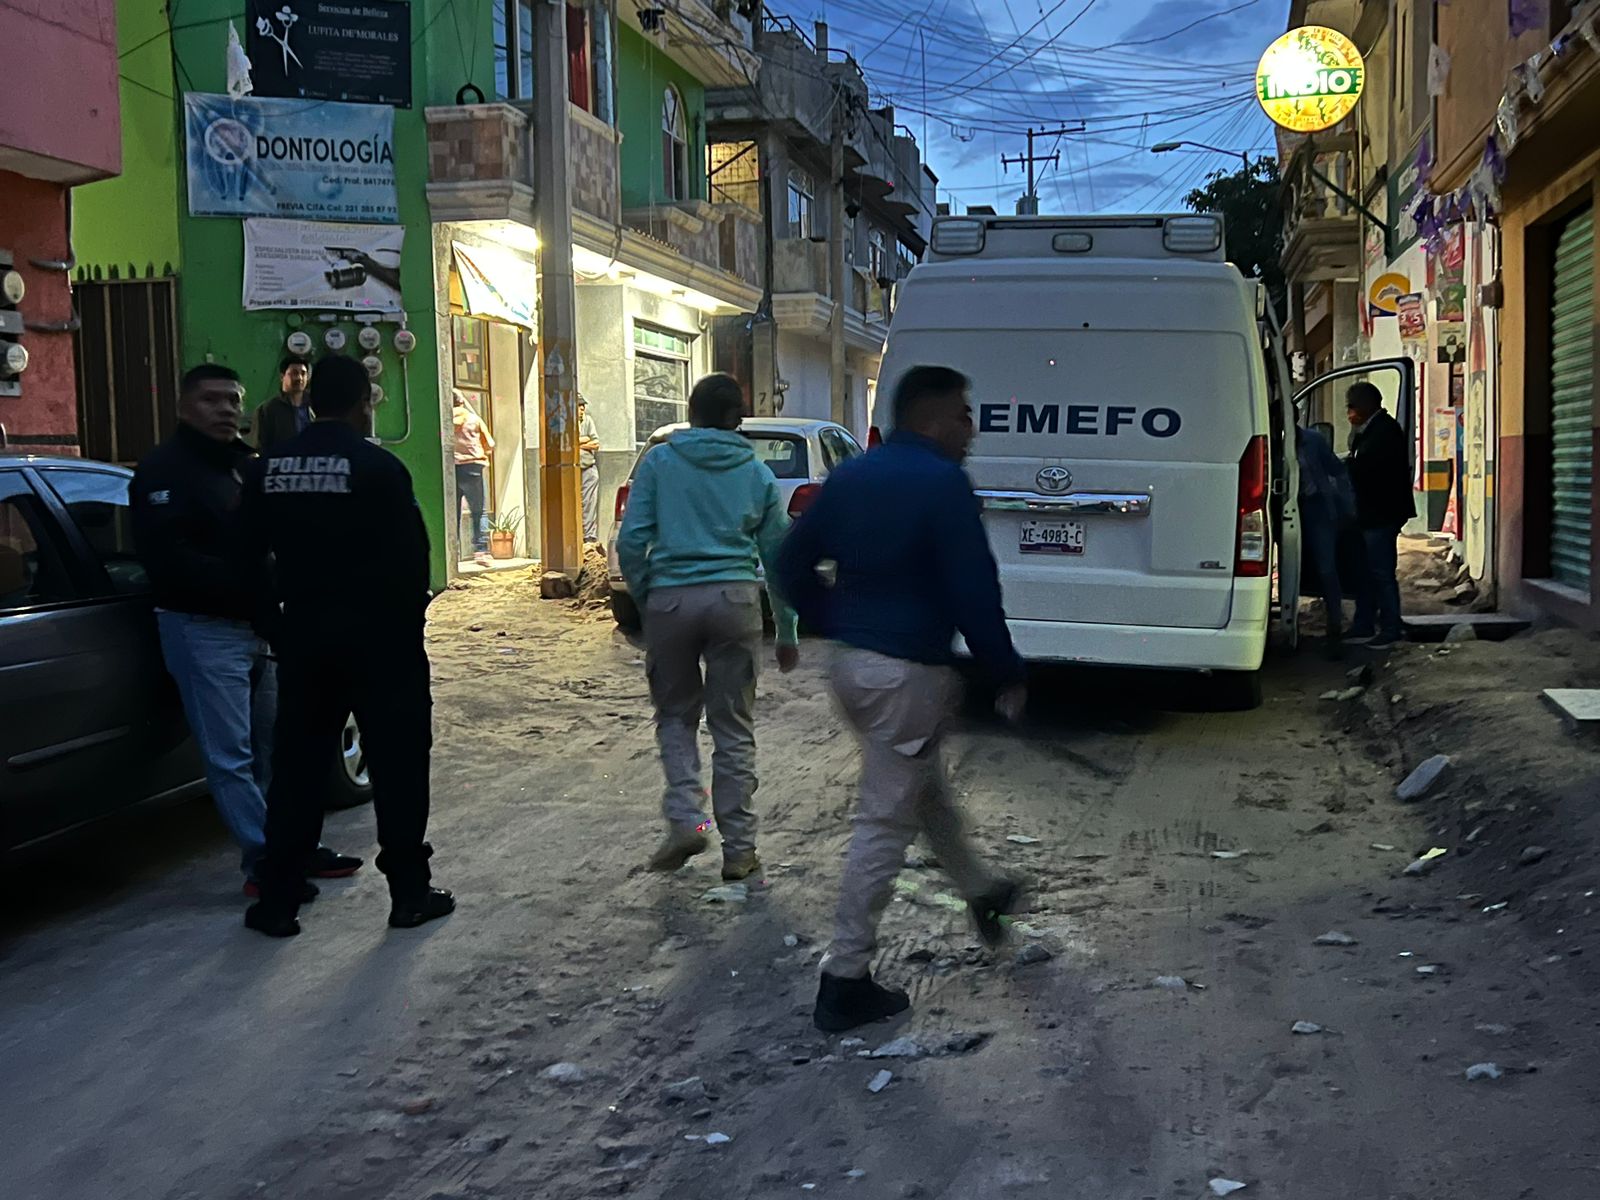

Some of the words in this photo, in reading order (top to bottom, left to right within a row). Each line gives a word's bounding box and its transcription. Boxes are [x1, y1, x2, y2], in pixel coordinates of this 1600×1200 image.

[1266, 70, 1352, 99] INDIO
[276, 202, 304, 211] PREVIA
[306, 203, 324, 211] CITA
[979, 402, 1182, 438] EMEFO
[264, 475, 351, 494] ESTATAL
[1021, 527, 1083, 545] XE-4983-C
